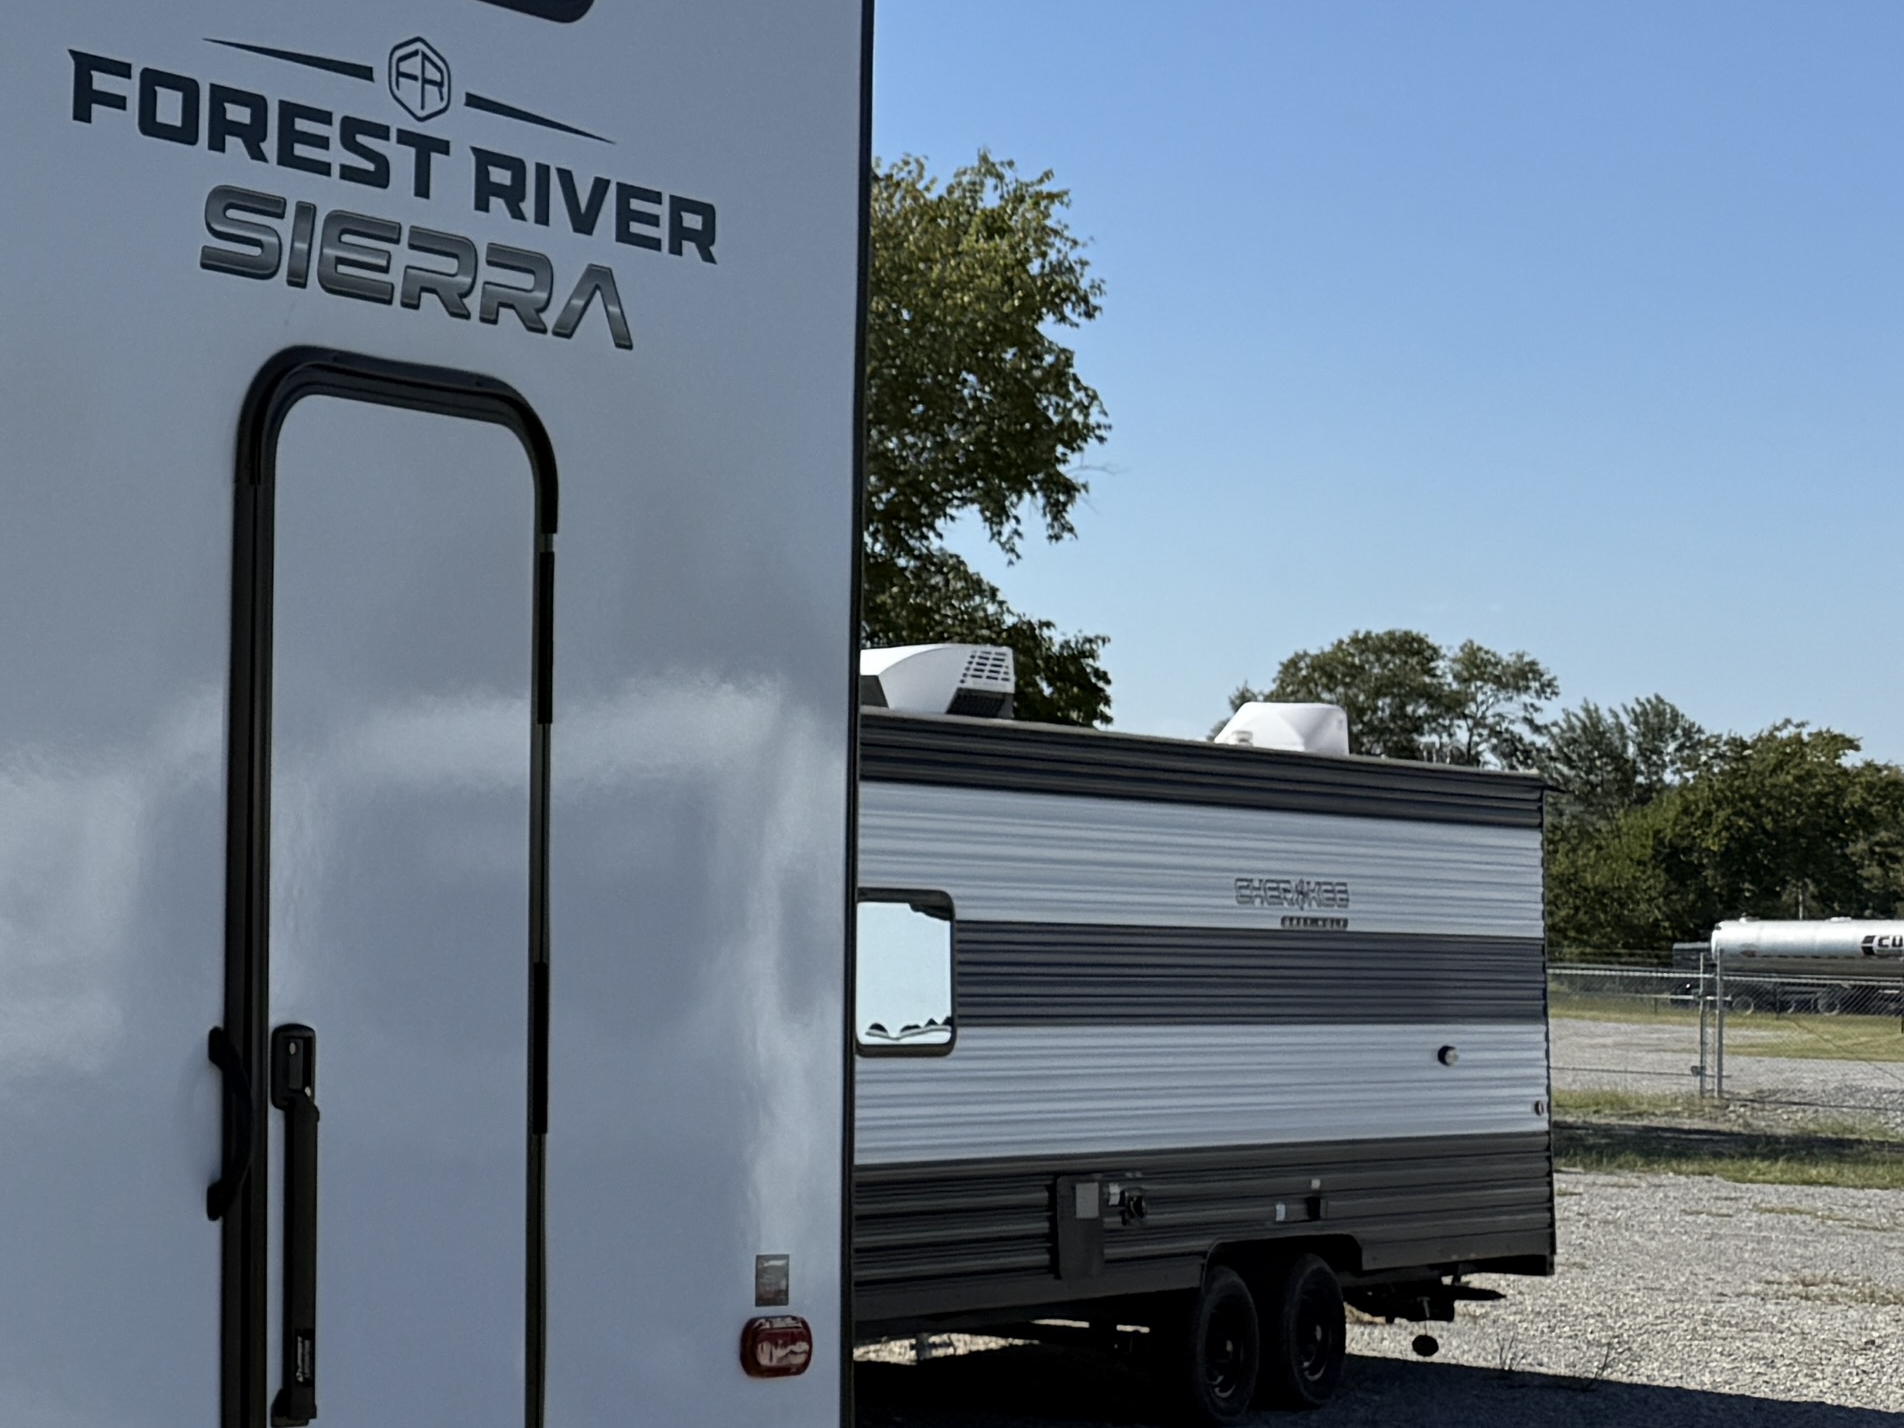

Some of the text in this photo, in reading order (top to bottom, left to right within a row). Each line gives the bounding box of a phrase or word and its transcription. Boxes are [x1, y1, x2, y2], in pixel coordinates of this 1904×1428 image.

[67, 49, 717, 264] FOREST RIVER
[200, 185, 633, 350] SIERRA
